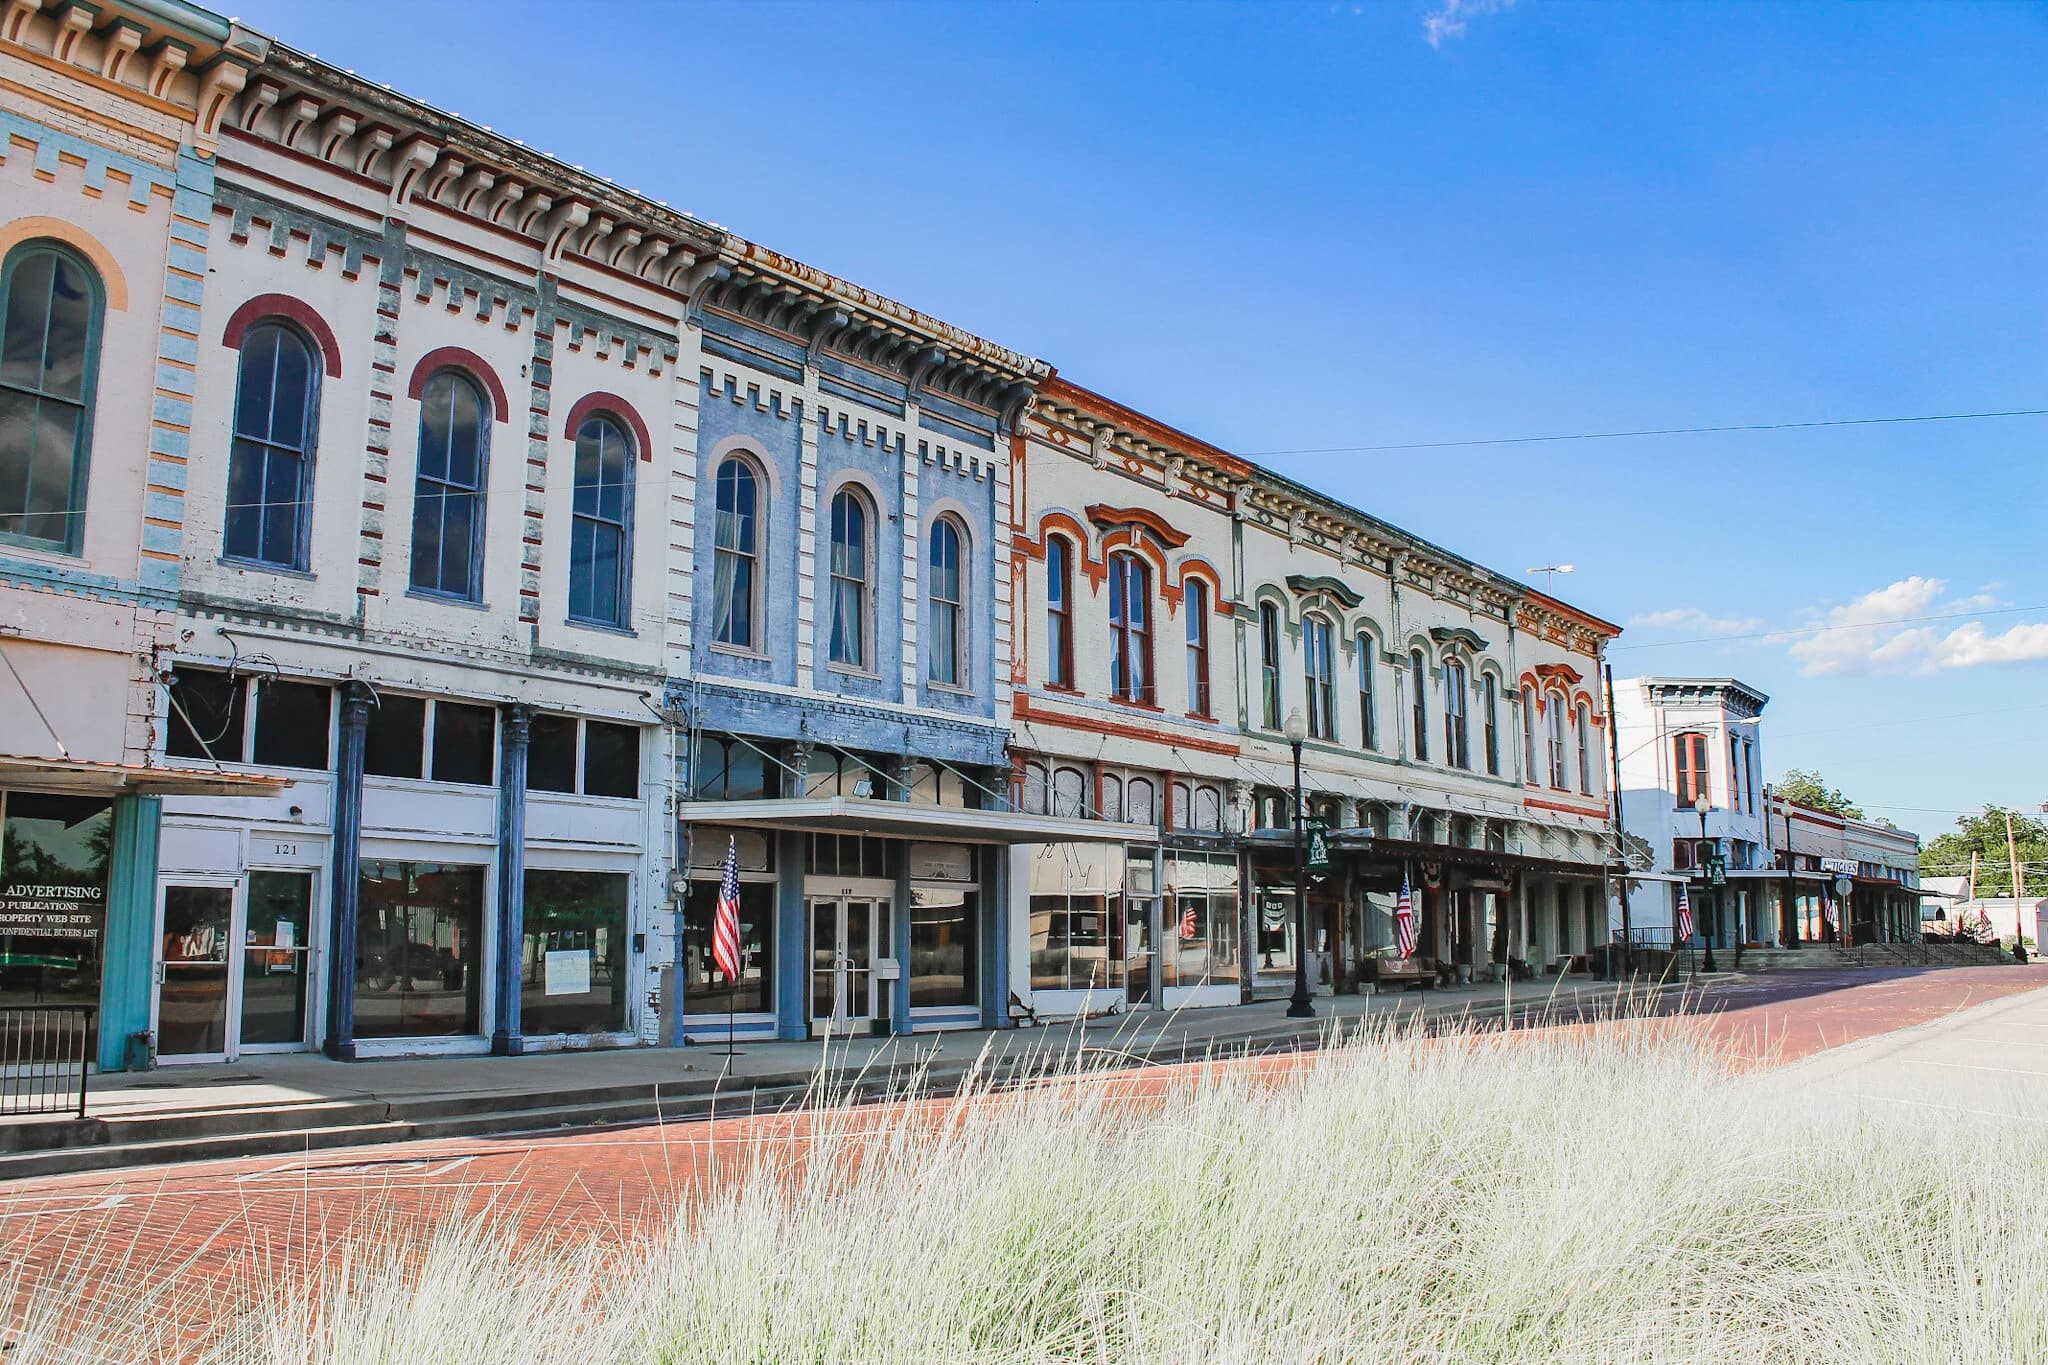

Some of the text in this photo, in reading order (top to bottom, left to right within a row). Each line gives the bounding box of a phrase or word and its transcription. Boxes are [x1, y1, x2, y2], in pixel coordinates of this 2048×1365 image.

[274, 844, 296, 856] 121
[5, 884, 102, 899] ADVERTISING
[7, 901, 79, 911] PUBLICATIONS
[46, 914, 68, 923] WEB
[70, 915, 92, 924] SITE
[54, 928, 82, 937] BUYERS
[83, 929, 99, 938] LIST
